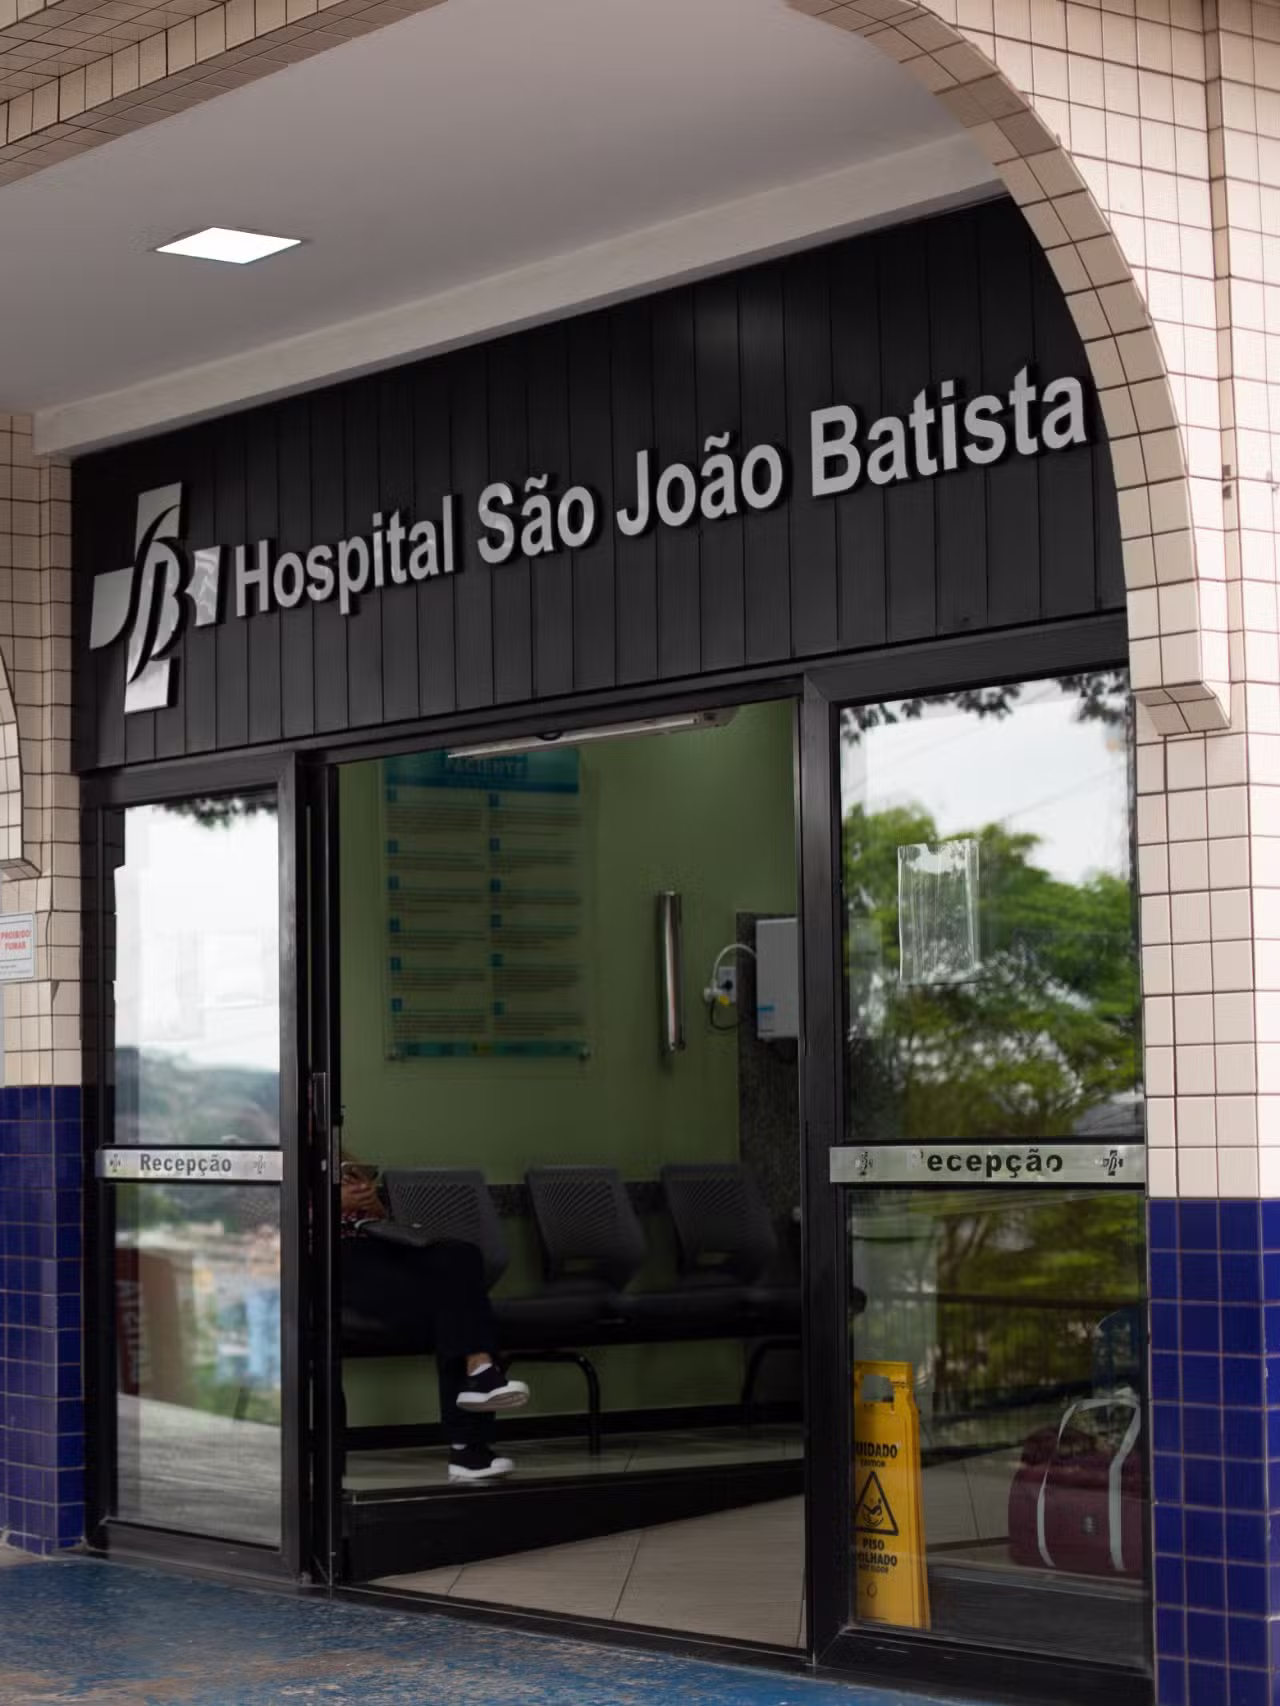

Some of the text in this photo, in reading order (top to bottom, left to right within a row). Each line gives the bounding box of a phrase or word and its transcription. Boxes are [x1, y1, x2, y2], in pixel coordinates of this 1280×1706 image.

[235, 364, 1087, 617] Hospital São João Batista
[4, 941, 27, 950] FUMAR
[140, 1153, 232, 1176] Recepção
[921, 1148, 1063, 1178] ecepção
[856, 1441, 898, 1458] UIDADO
[863, 1538, 885, 1551] PISO
[857, 1552, 897, 1567] OLHADO
